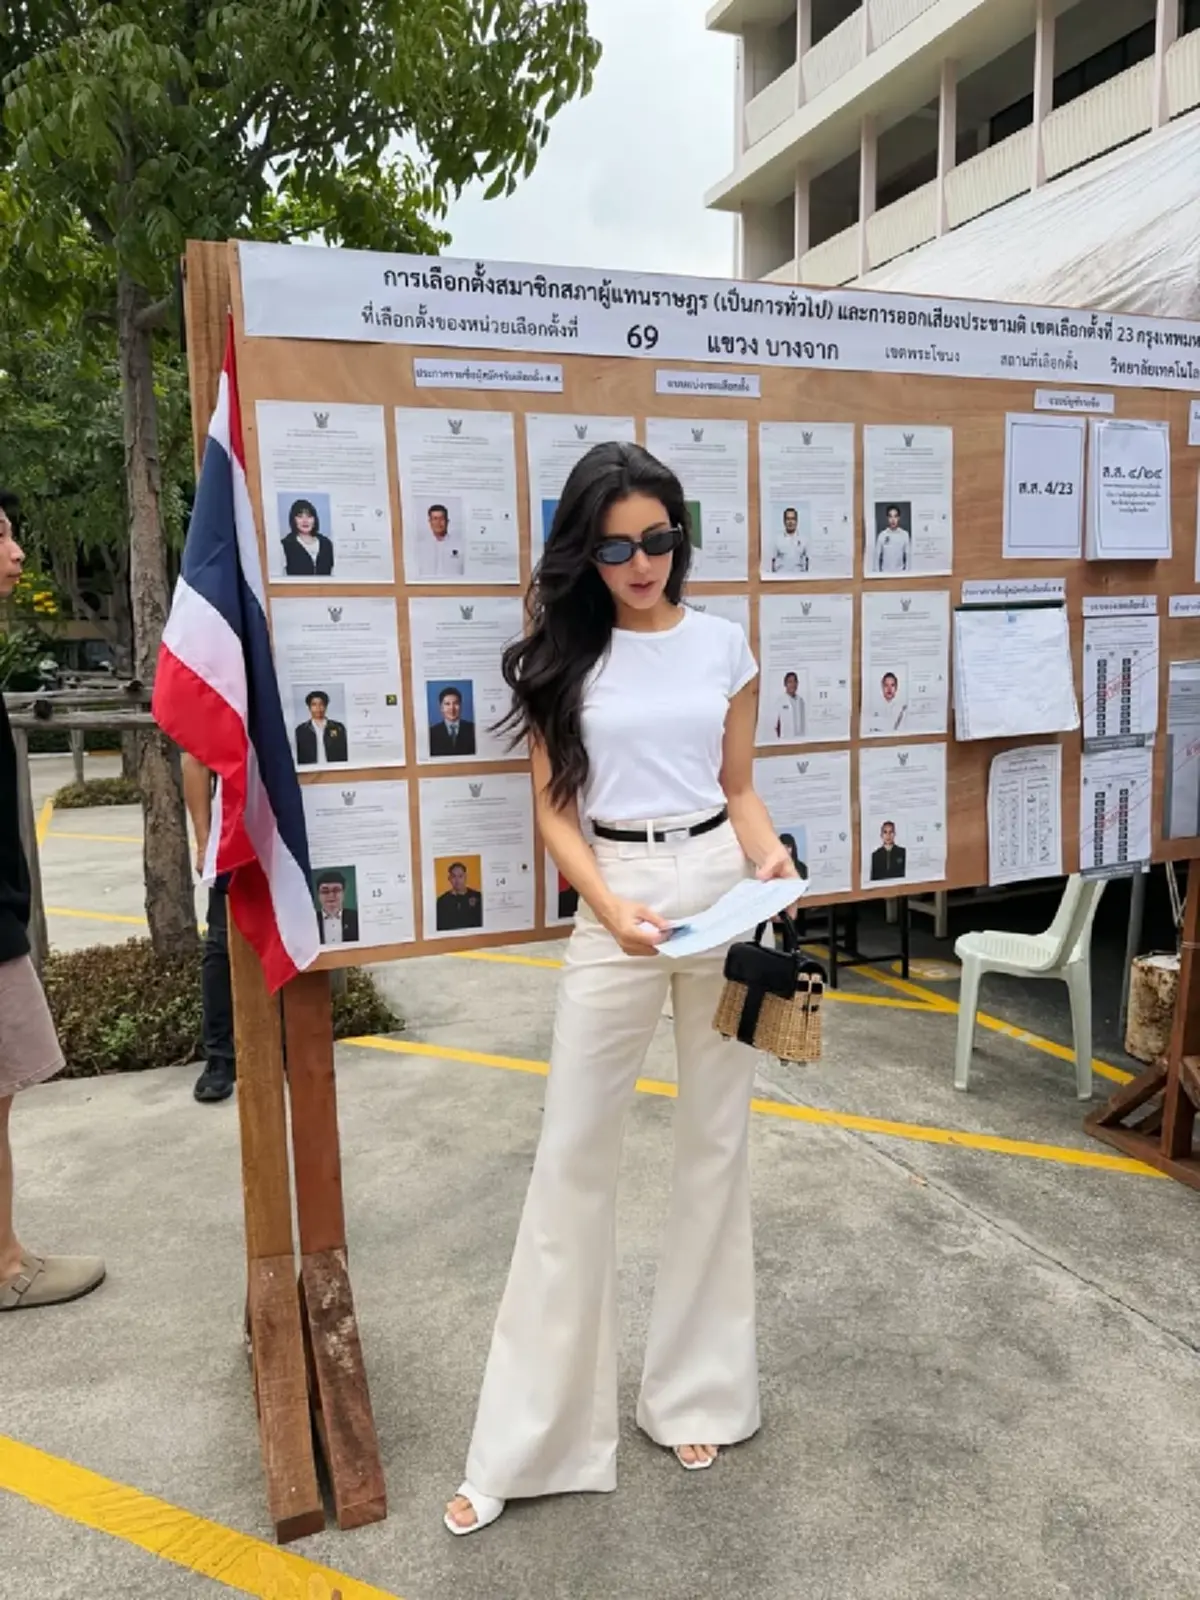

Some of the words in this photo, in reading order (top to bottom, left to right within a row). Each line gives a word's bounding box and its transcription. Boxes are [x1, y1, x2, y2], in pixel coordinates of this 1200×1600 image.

[383, 262, 708, 316] การเลือกตั้งสมาชิกสภาผู้แทนราษฎร
[713, 288, 833, 320] (เป็นการทั่วไป)
[837, 304, 1027, 335] และการออกเสียงประชามติ
[1030, 314, 1113, 341] เขตเลือกตั้งที่
[1116, 326, 1134, 343] 23
[361, 301, 579, 338] ที่เลือกตั้งของหน่วยเลือกตั้งที่
[627, 324, 659, 350] 69
[707, 334, 758, 355] แขวง
[765, 338, 839, 360] บางจาก
[885, 344, 961, 363] เขตพระโขนง
[1000, 348, 1078, 371] สถานที่เลือกตั้ง
[1044, 481, 1074, 496] 4/23
[351, 522, 356, 532] 1
[480, 526, 487, 534] 2
